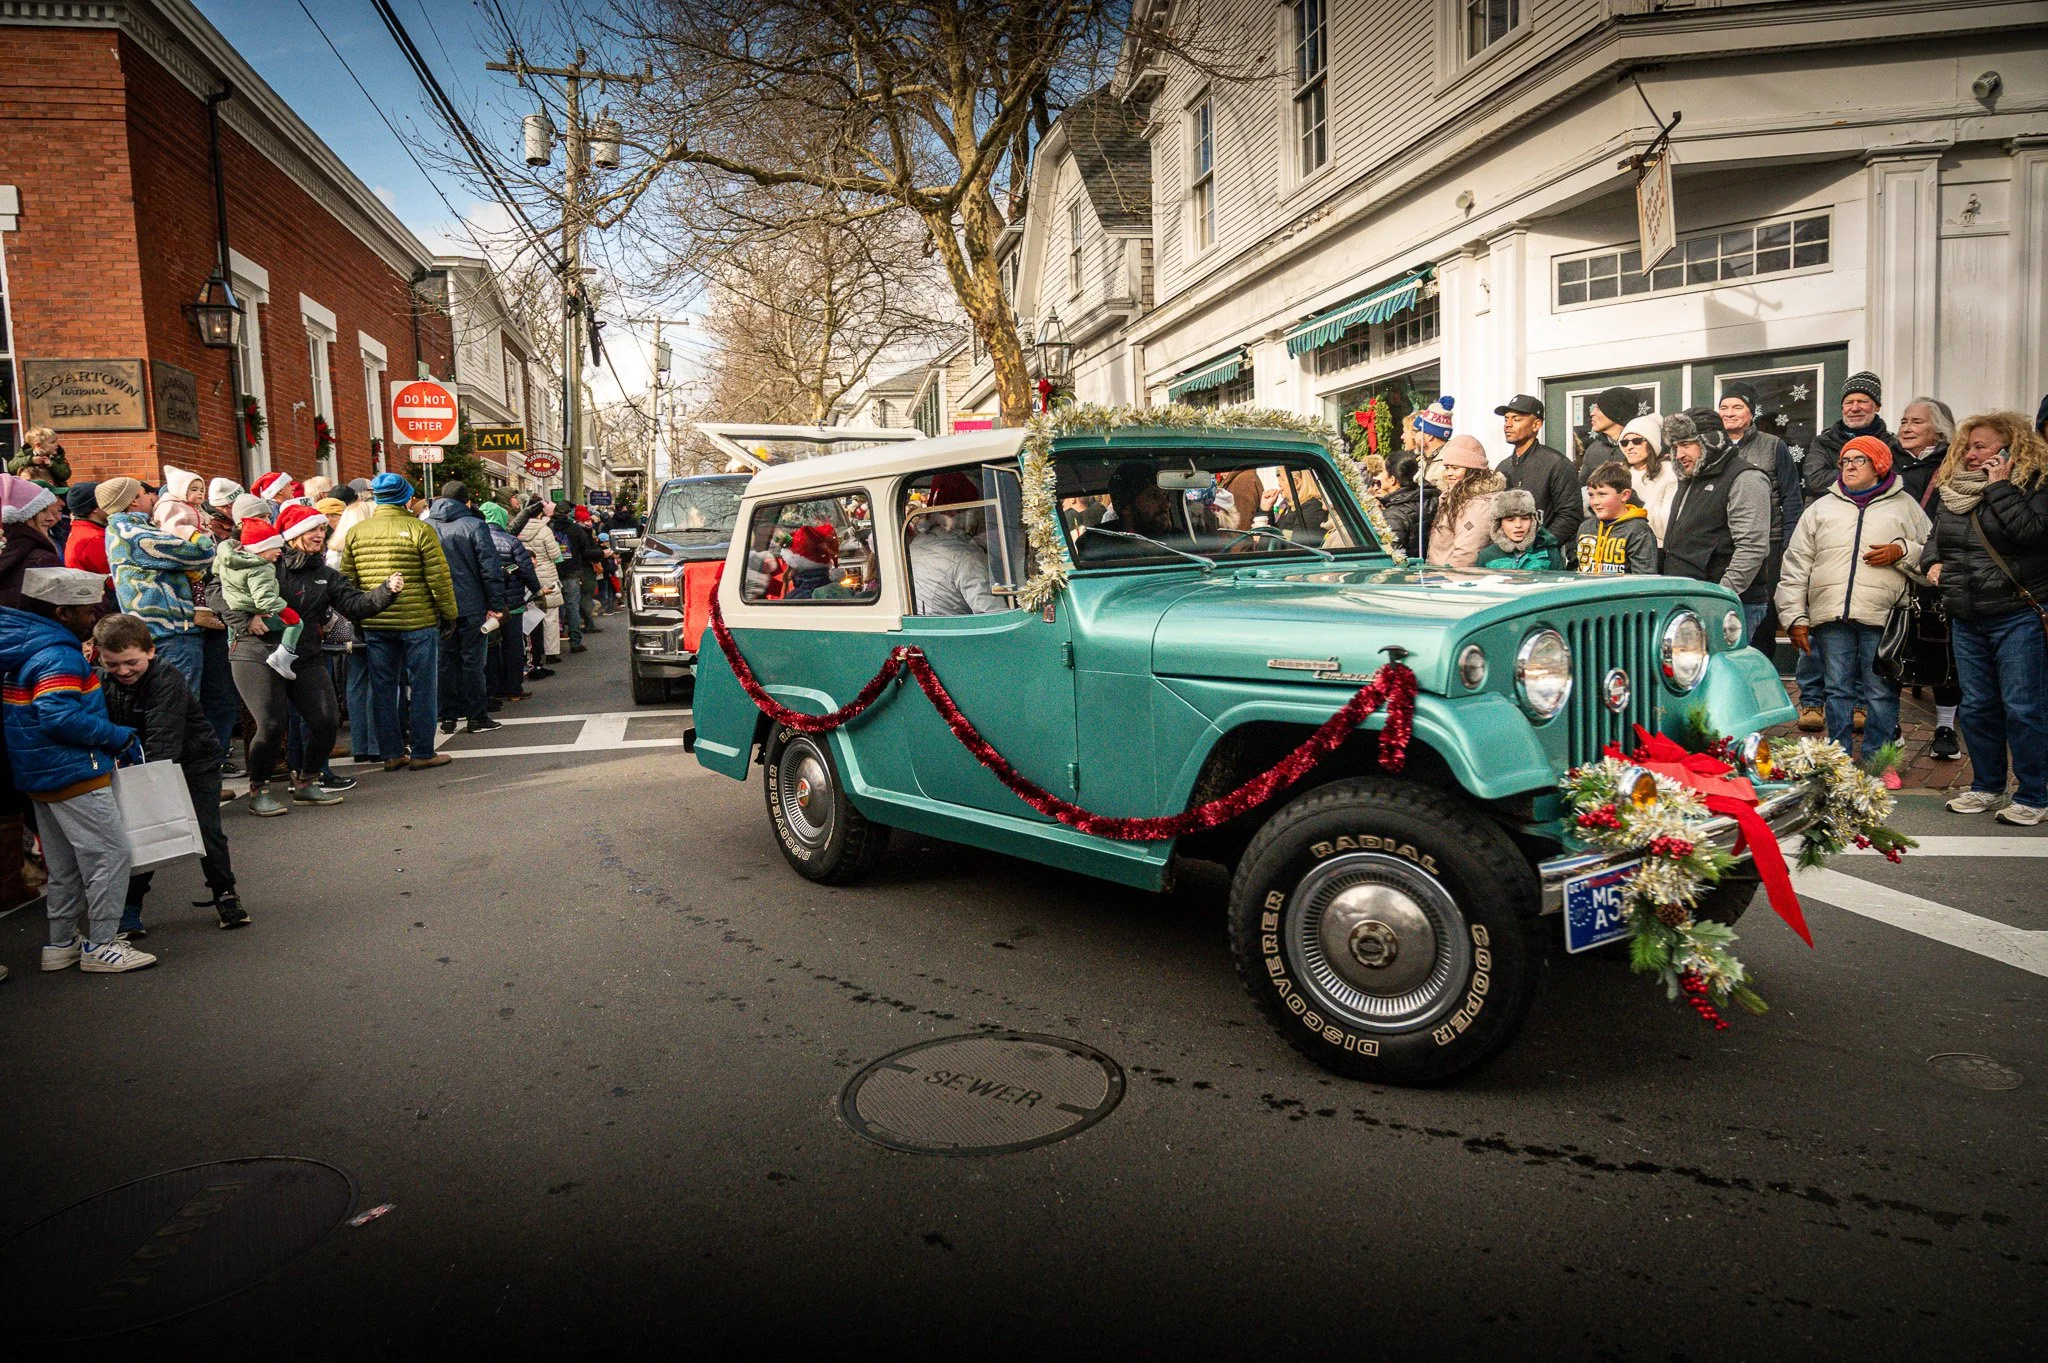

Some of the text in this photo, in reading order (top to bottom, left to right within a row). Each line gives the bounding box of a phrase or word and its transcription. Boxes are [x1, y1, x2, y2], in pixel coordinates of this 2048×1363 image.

[30, 371, 140, 399] EDGARTOWN
[61, 388, 108, 396] NATIONAL
[404, 395, 446, 405] DO NOT
[51, 403, 121, 417] BANK
[408, 421, 442, 431] ENTER
[481, 433, 520, 447] ATM
[527, 453, 557, 464] SUMMER
[528, 467, 557, 476] SHADES
[769, 764, 812, 861] DISCOVERER
[1310, 834, 1440, 875] RADIAL
[1260, 890, 1380, 1057] DISCOVERER
[1431, 923, 1492, 1046] COOPER
[923, 1069, 1043, 1108] SEWER
